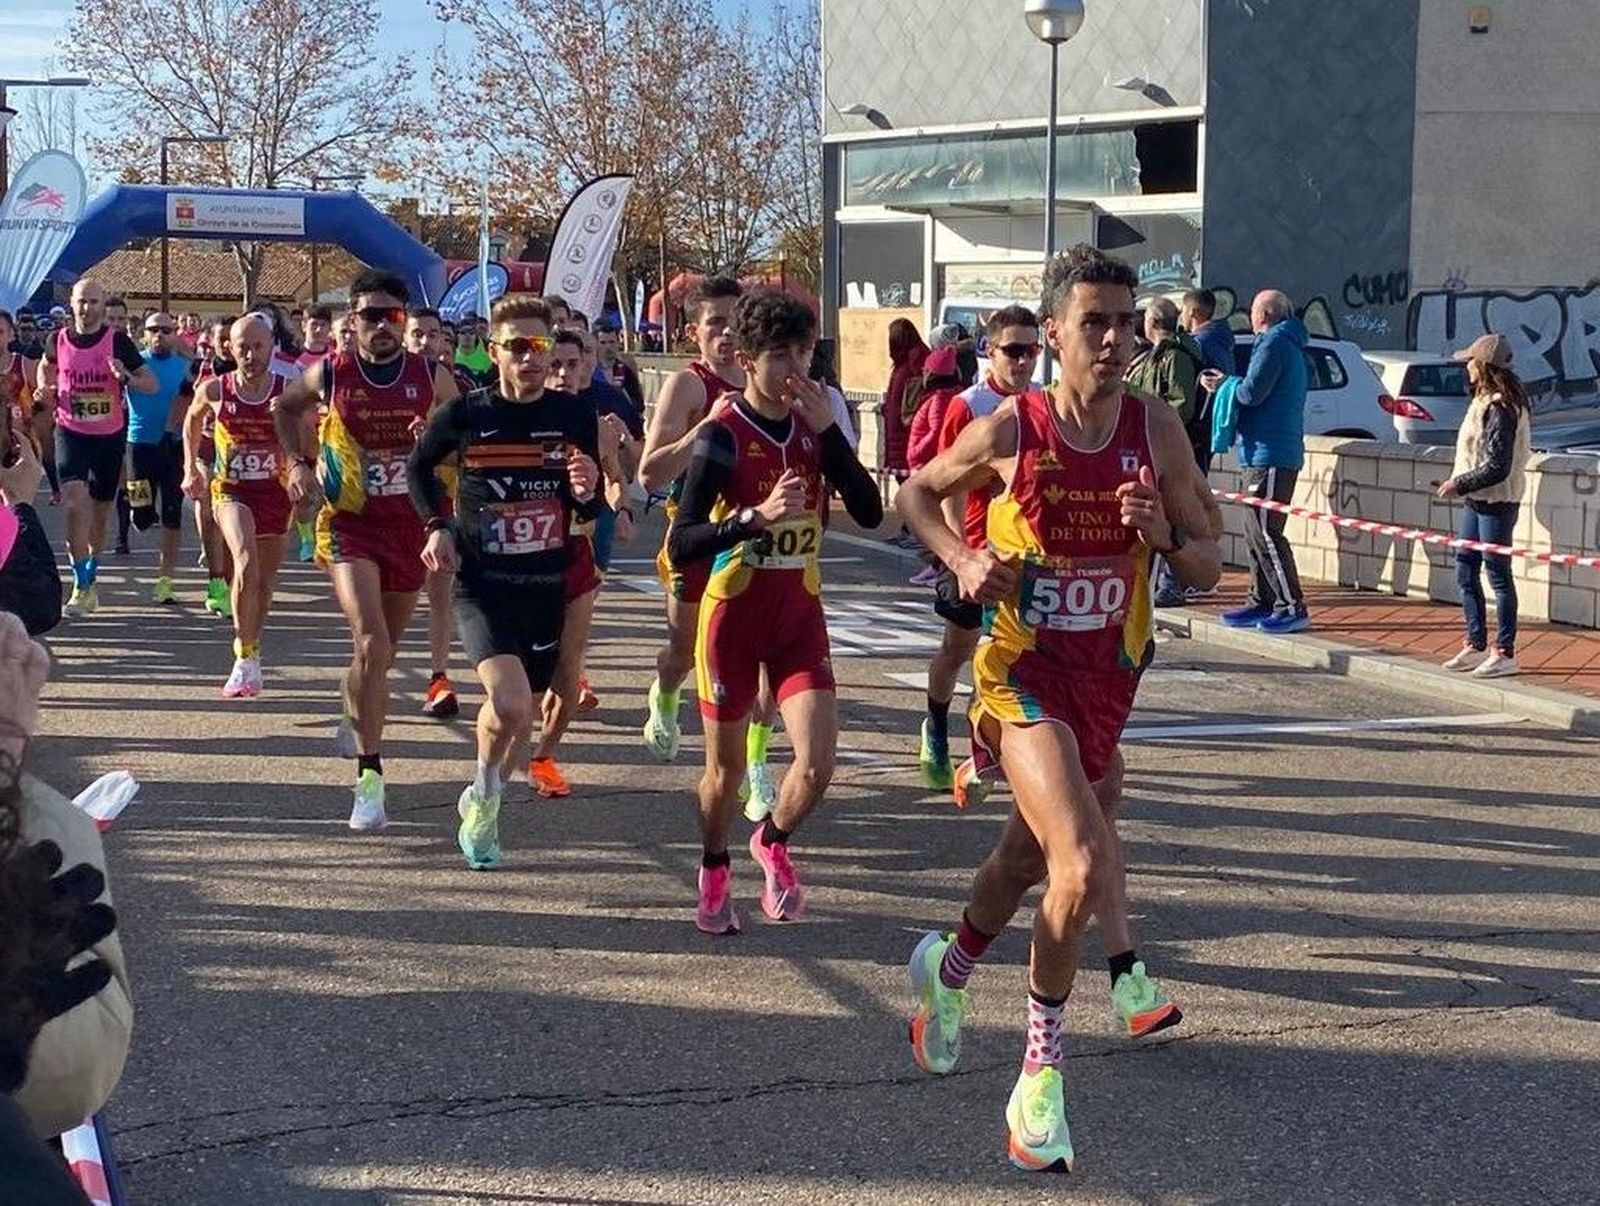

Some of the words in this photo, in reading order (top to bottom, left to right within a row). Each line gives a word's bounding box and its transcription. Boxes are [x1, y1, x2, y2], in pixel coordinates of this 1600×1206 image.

[230, 454, 276, 471] 494
[519, 480, 561, 491] VICKY
[1067, 511, 1111, 525] VINO
[490, 514, 556, 543] 197
[1050, 528, 1075, 540] DE
[1076, 527, 1126, 541] TORO
[1031, 577, 1126, 614] 500
